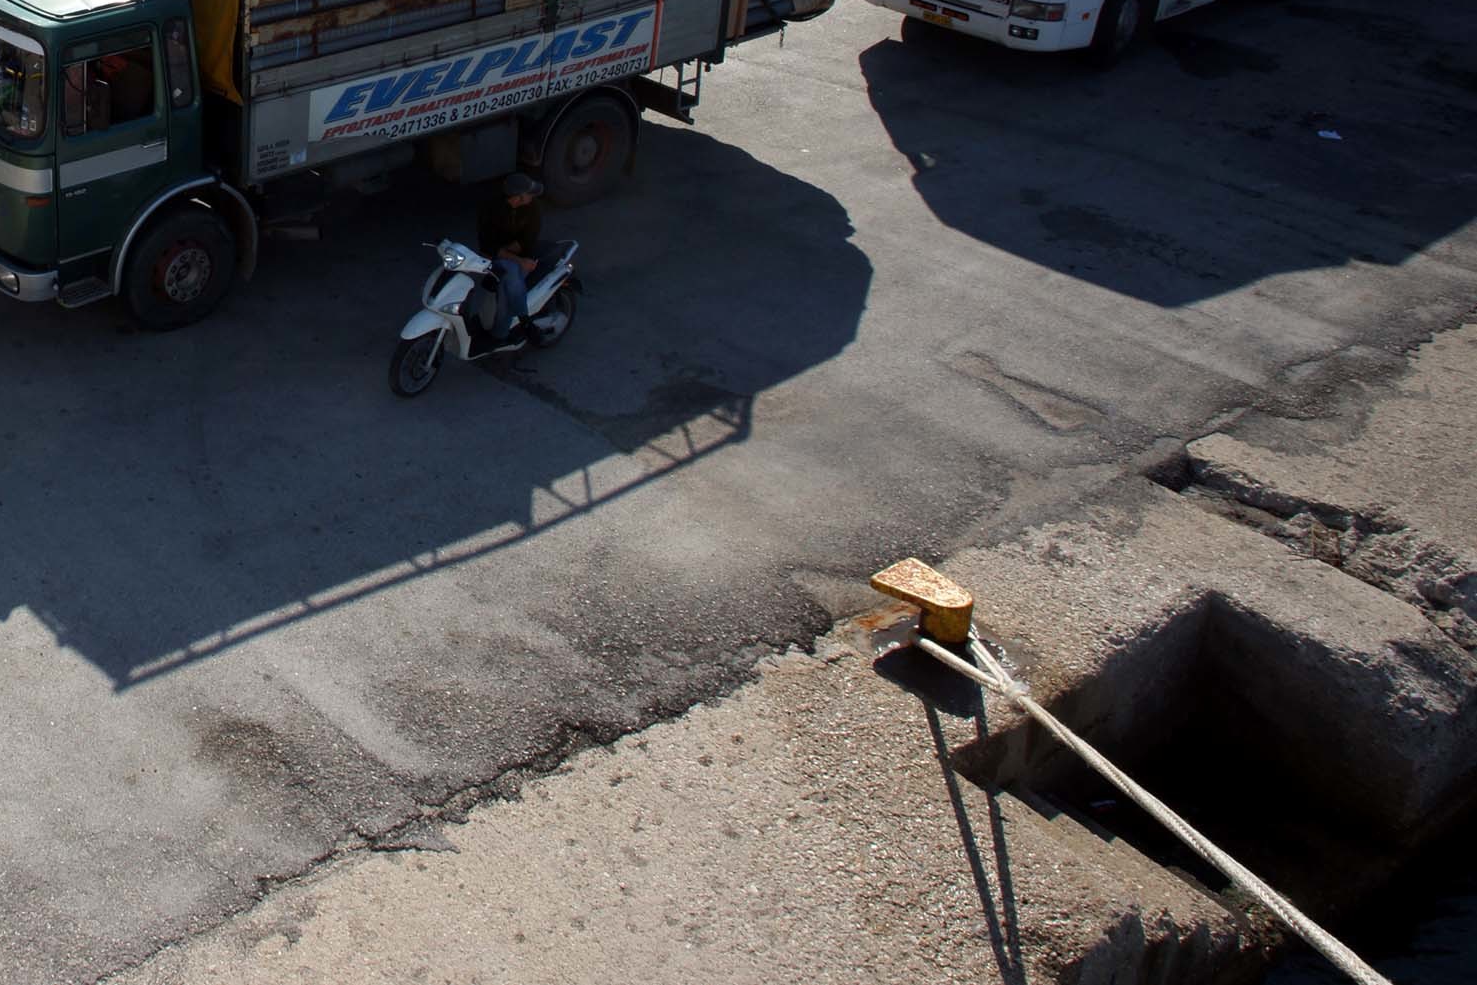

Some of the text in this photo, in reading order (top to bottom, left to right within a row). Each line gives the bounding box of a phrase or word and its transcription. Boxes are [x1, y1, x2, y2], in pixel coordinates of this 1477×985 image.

[325, 10, 654, 124] EVELPLAST
[450, 108, 459, 122] &
[463, 85, 543, 119] 210-2480730
[545, 78, 573, 96] FAX:
[575, 55, 649, 88] 210-2480731
